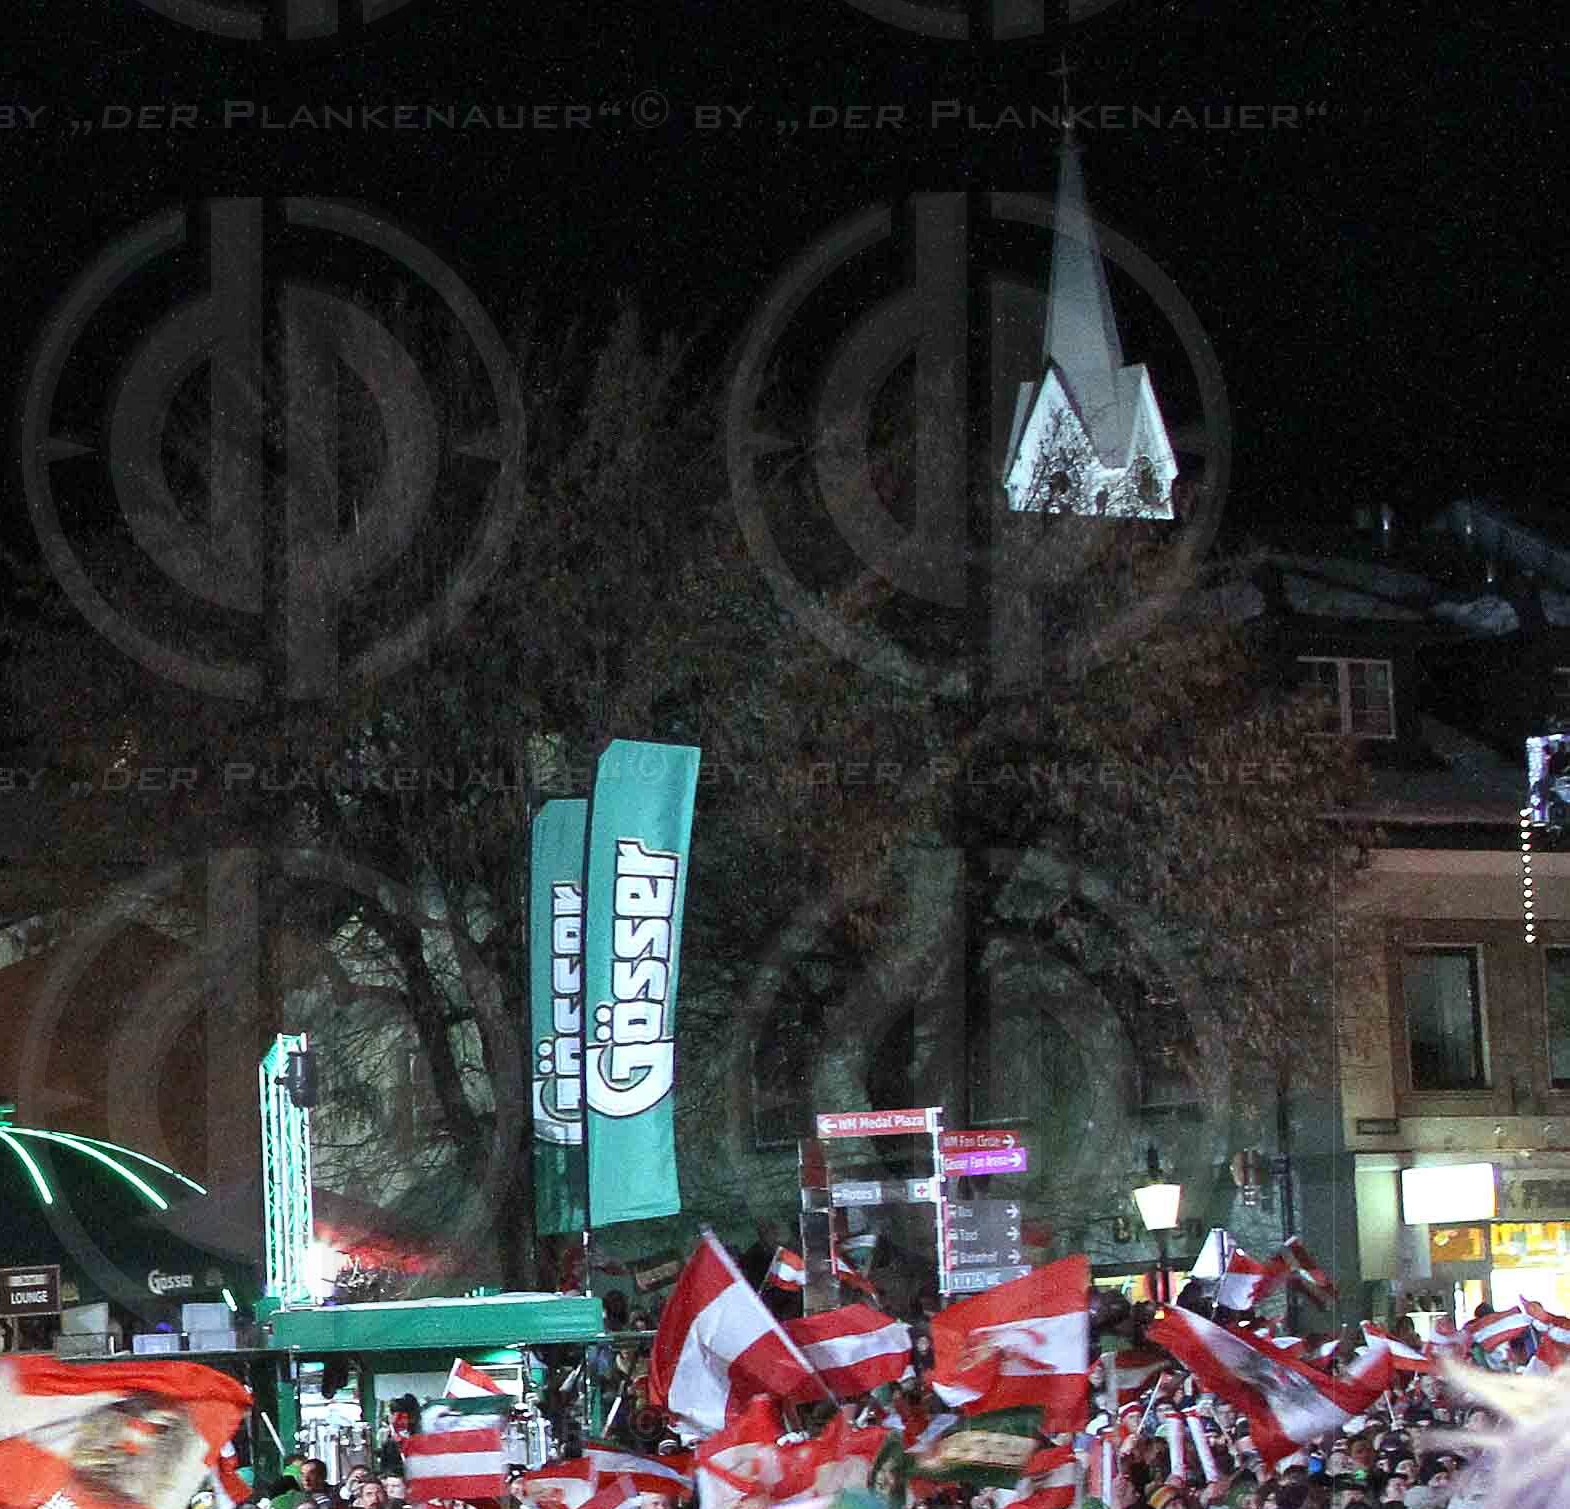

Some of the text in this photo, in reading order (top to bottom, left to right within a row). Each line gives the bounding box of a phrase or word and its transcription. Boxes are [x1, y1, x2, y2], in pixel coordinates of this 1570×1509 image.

[586, 838, 679, 1118] Gösser
[860, 1116, 892, 1129] Medal
[894, 1114, 925, 1127] Plaza
[10, 1290, 49, 1305] LOUNGE
